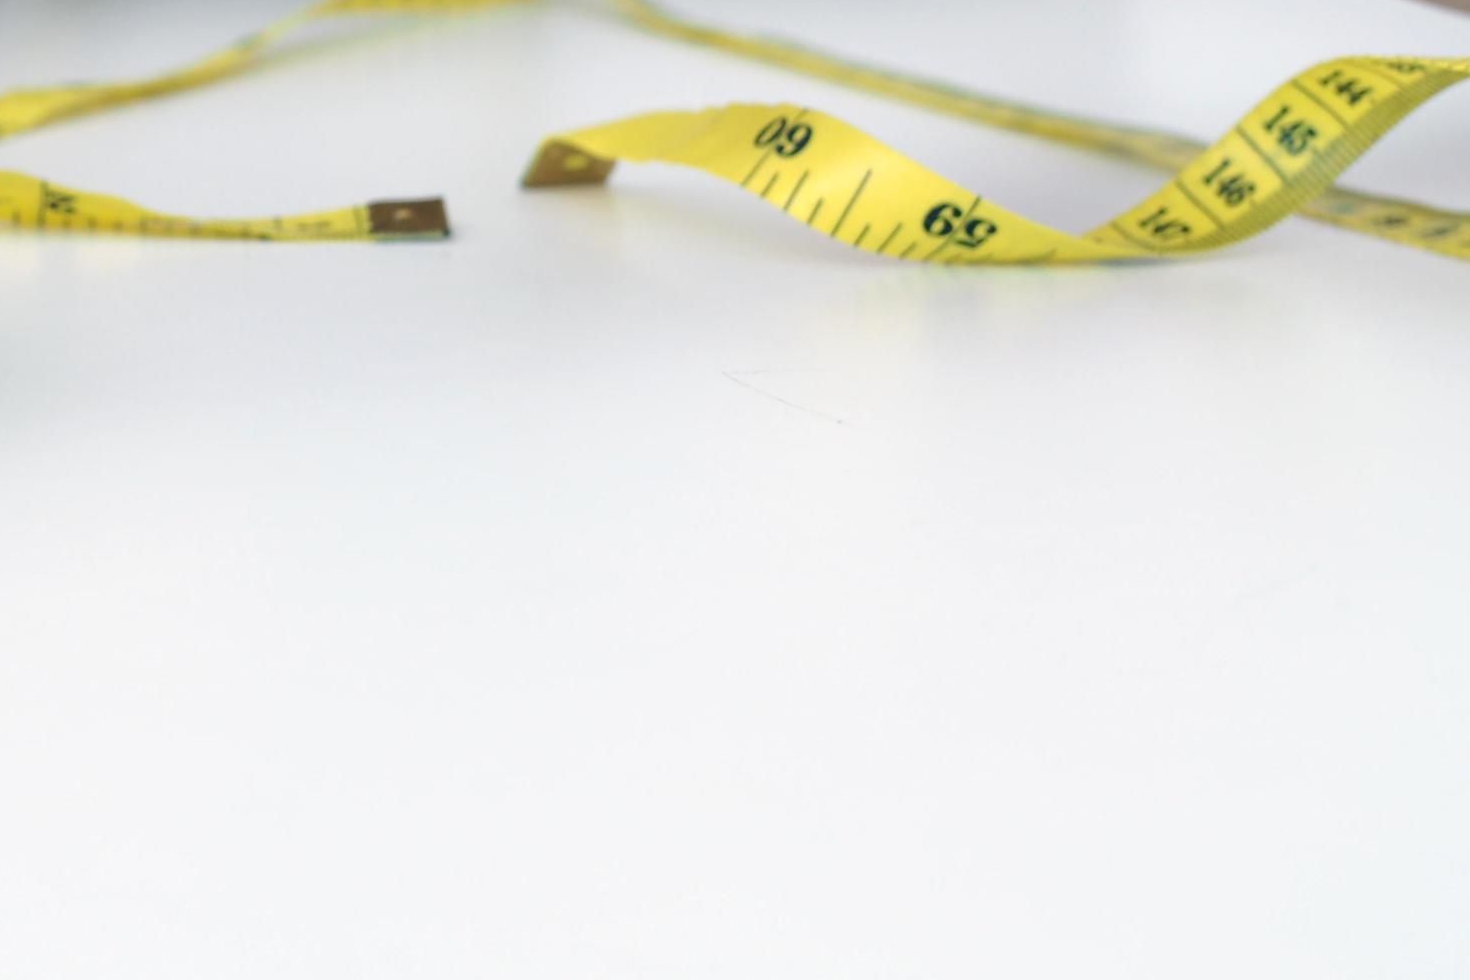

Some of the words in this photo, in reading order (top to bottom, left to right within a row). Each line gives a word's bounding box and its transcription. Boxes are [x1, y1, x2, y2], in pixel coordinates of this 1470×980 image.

[1318, 70, 1374, 106] 144
[753, 117, 814, 158] 60
[1263, 106, 1318, 156] 145
[1202, 159, 1258, 208] 146
[923, 202, 998, 249] 59
